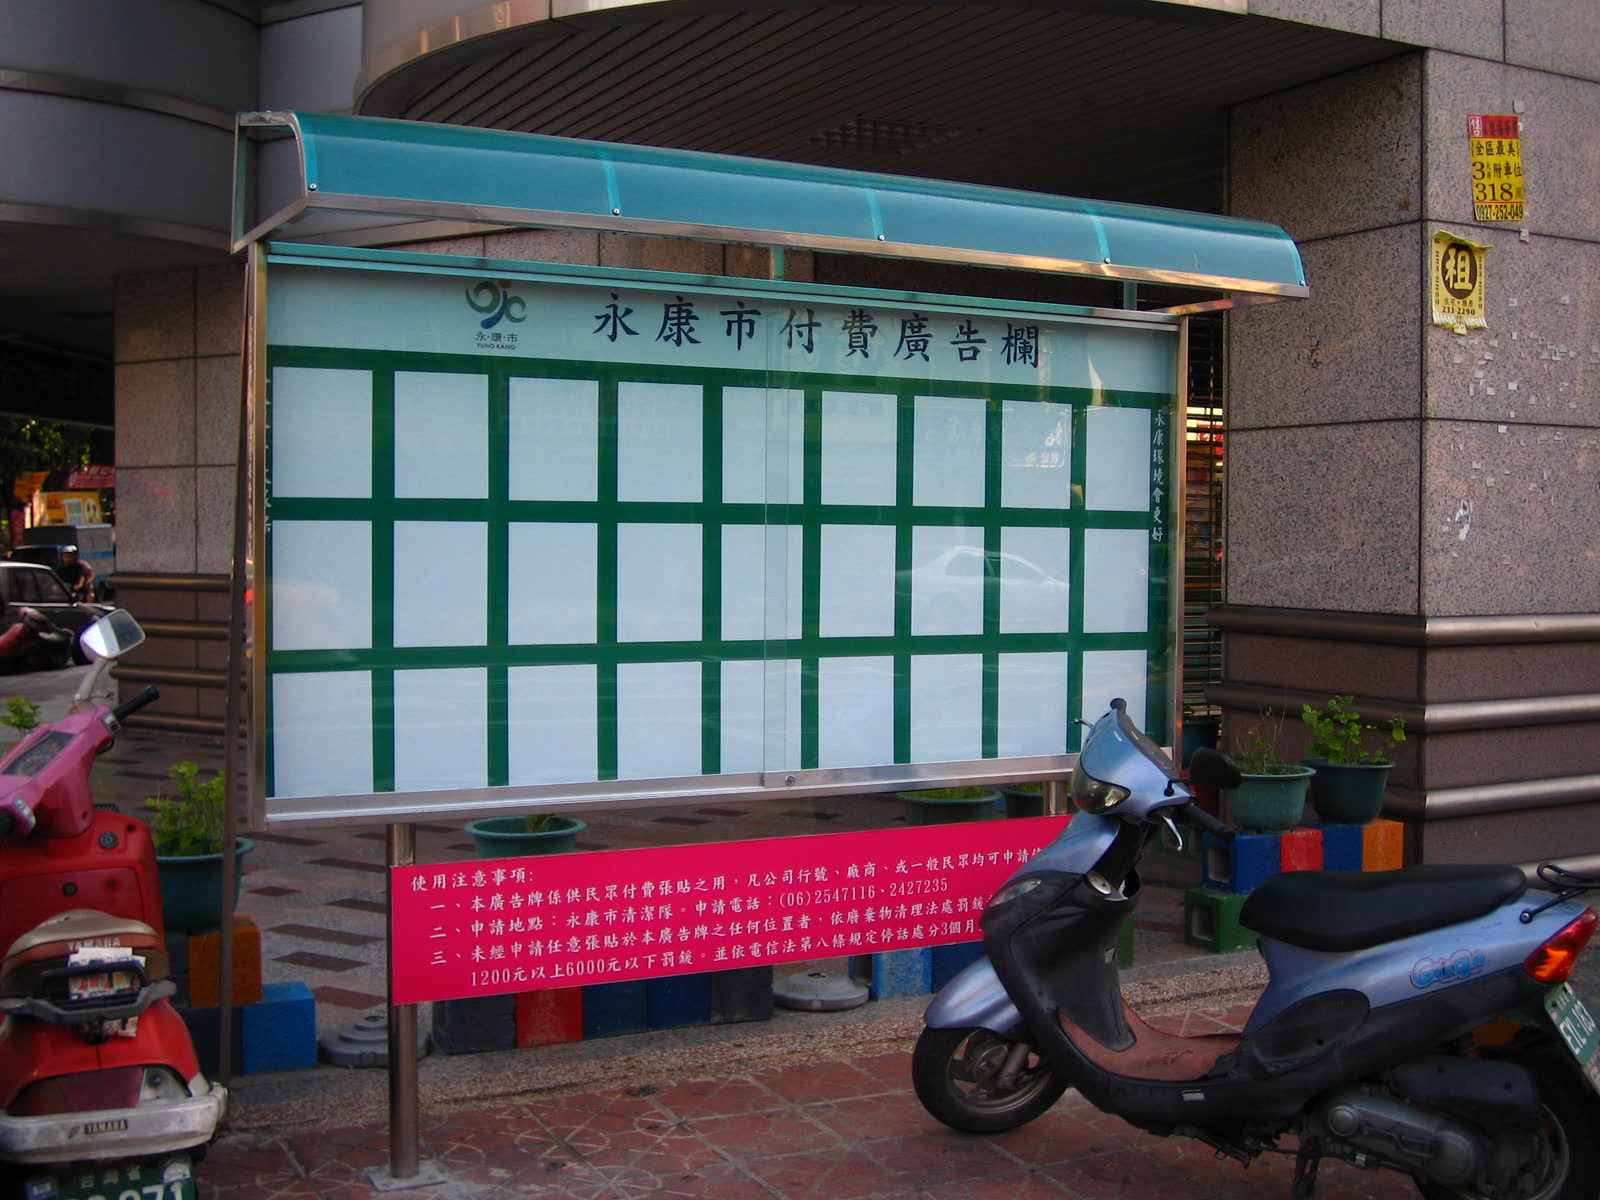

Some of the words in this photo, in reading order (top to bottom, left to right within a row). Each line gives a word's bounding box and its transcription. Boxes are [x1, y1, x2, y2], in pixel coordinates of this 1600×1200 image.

[592, 292, 1040, 369] 永康市付費廣告欄
[1151, 409, 1167, 543] 永康環境會更好
[430, 894, 992, 965] 三、未經申請任意張貼於本廣告牌之任何位置者，依廢棄物清理法處罰鍰
[471, 918, 982, 987] 1200元以上6000元以下罰鍰。並依電信法第八條規定停話處分3個月
[86, 1119, 128, 1135] YAMAHA
